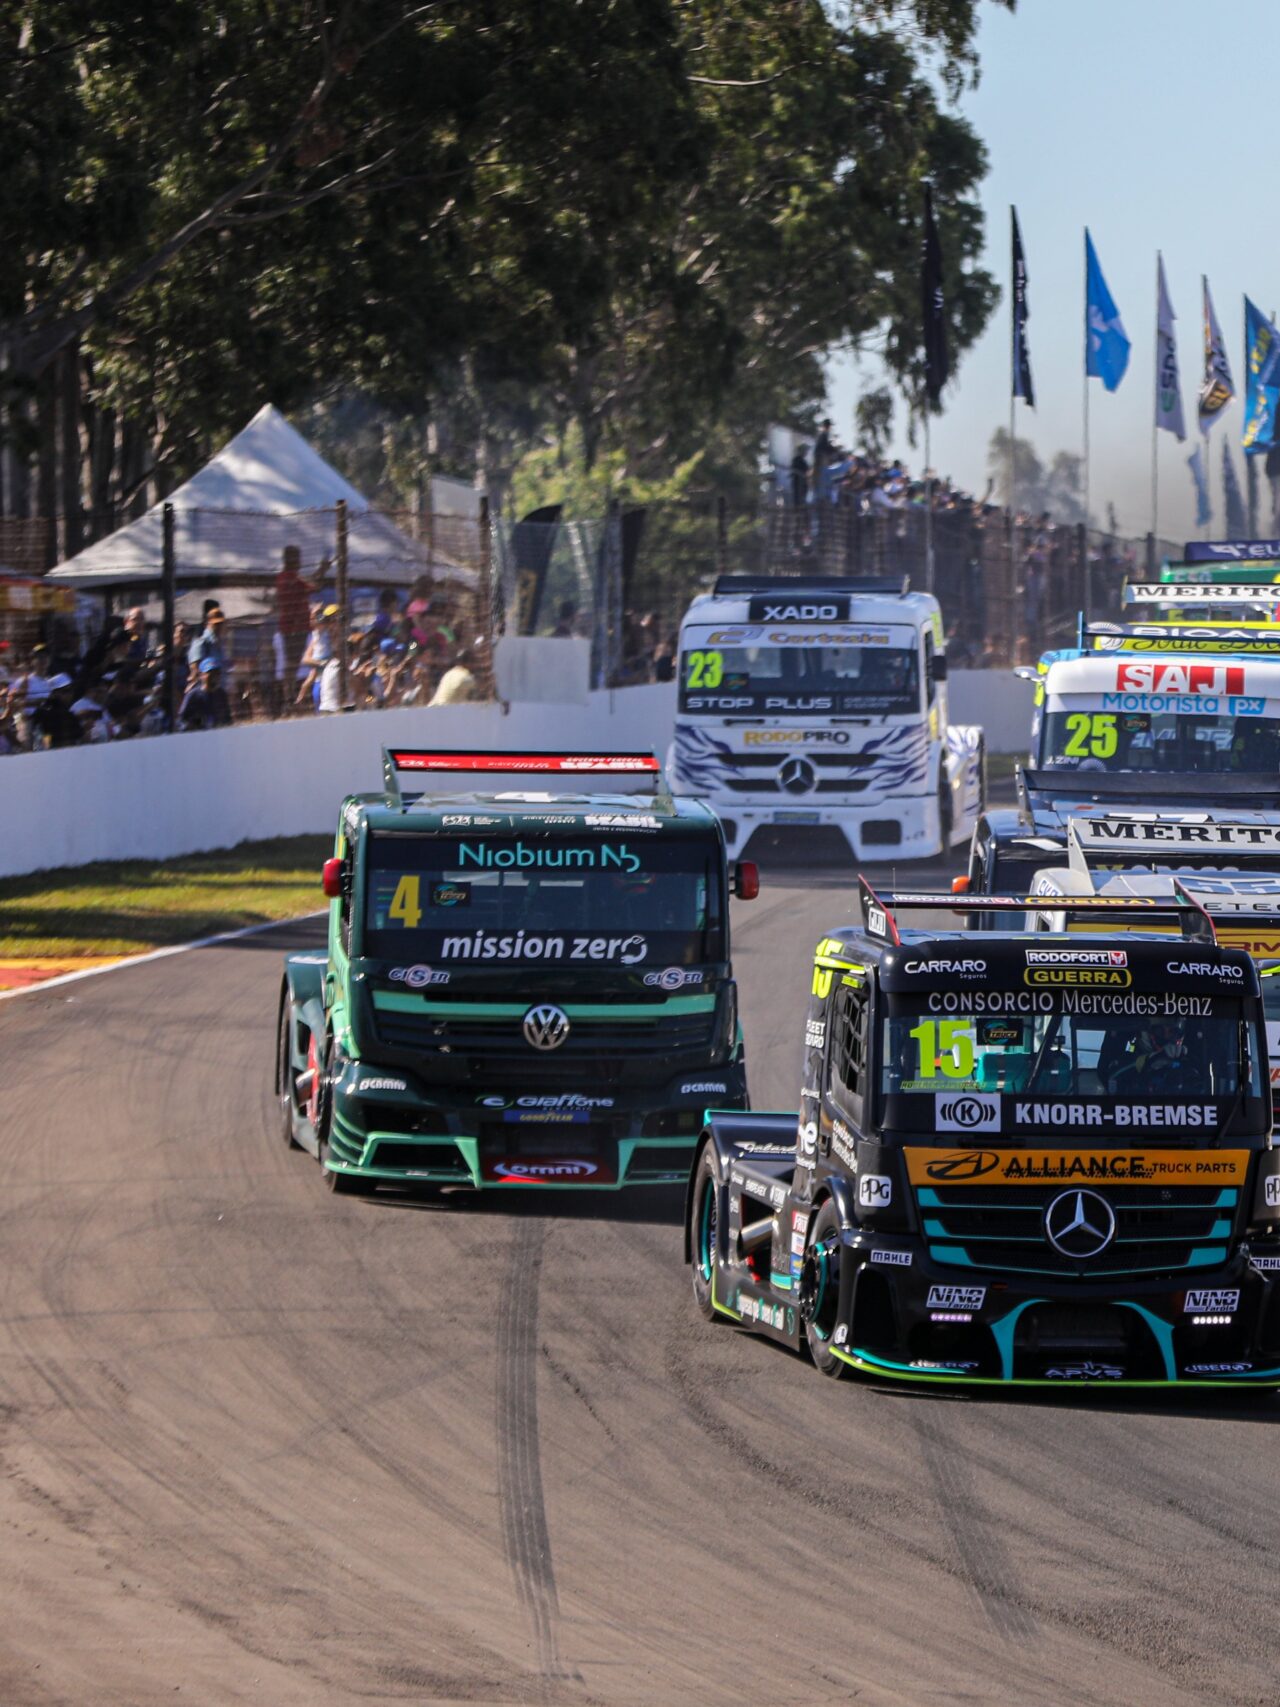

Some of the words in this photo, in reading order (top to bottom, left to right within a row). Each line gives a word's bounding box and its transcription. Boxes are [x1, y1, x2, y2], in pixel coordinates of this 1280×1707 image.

[763, 605, 838, 620] XADO
[687, 651, 723, 689] 23
[1123, 666, 1228, 694] SAJ
[687, 698, 754, 709] STOP
[766, 698, 832, 710] PLUS
[1102, 692, 1219, 713] Motorista
[1065, 714, 1118, 759] 25
[584, 816, 663, 829] BRASIL
[459, 842, 594, 867] Niobium
[388, 875, 422, 928] 4
[441, 930, 563, 959] mission
[571, 934, 648, 965] zero
[1029, 952, 1108, 964] RODOFORT
[905, 960, 987, 974] CARRARO
[1033, 970, 1122, 983] GUERRA
[1167, 962, 1243, 978] CARRARO
[929, 992, 1054, 1012] CONSORCIO
[1061, 990, 1213, 1016] Mercedes-Benz
[910, 1020, 974, 1078] 15
[1015, 1103, 1218, 1126] KNORR-BREMSE
[1009, 1156, 1146, 1178] ALLIANCE
[1152, 1163, 1191, 1173] TRUCK
[1195, 1163, 1237, 1173] PARTS
[872, 1251, 911, 1265] MAHLE
